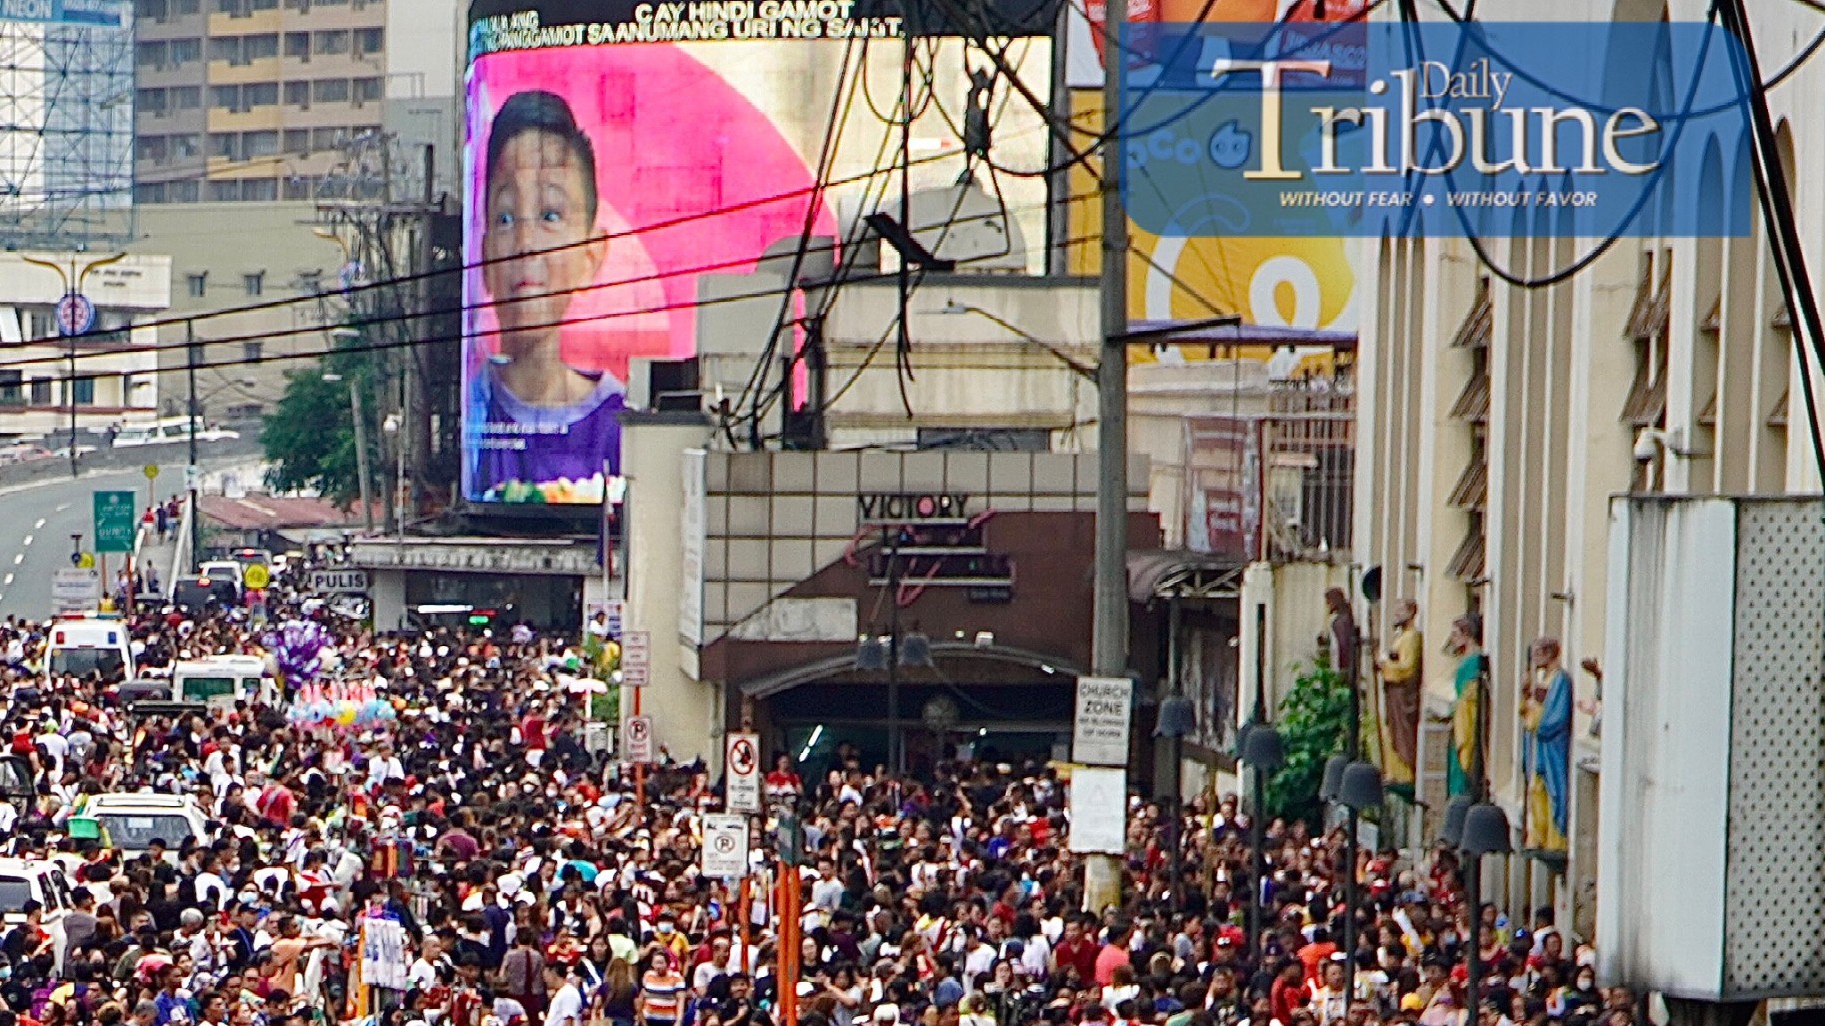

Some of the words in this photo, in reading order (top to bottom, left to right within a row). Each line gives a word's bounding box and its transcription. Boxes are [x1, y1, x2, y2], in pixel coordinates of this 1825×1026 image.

[3, 0, 53, 19] NEON
[688, 0, 754, 22] HINDI
[759, 0, 856, 20] GAMOT
[733, 18, 776, 39] URI
[780, 18, 822, 39] NG
[858, 494, 969, 519] VICTORY
[315, 573, 364, 589] PULIS
[1079, 683, 1129, 699] CHURCH
[1084, 701, 1123, 716] ZONE
